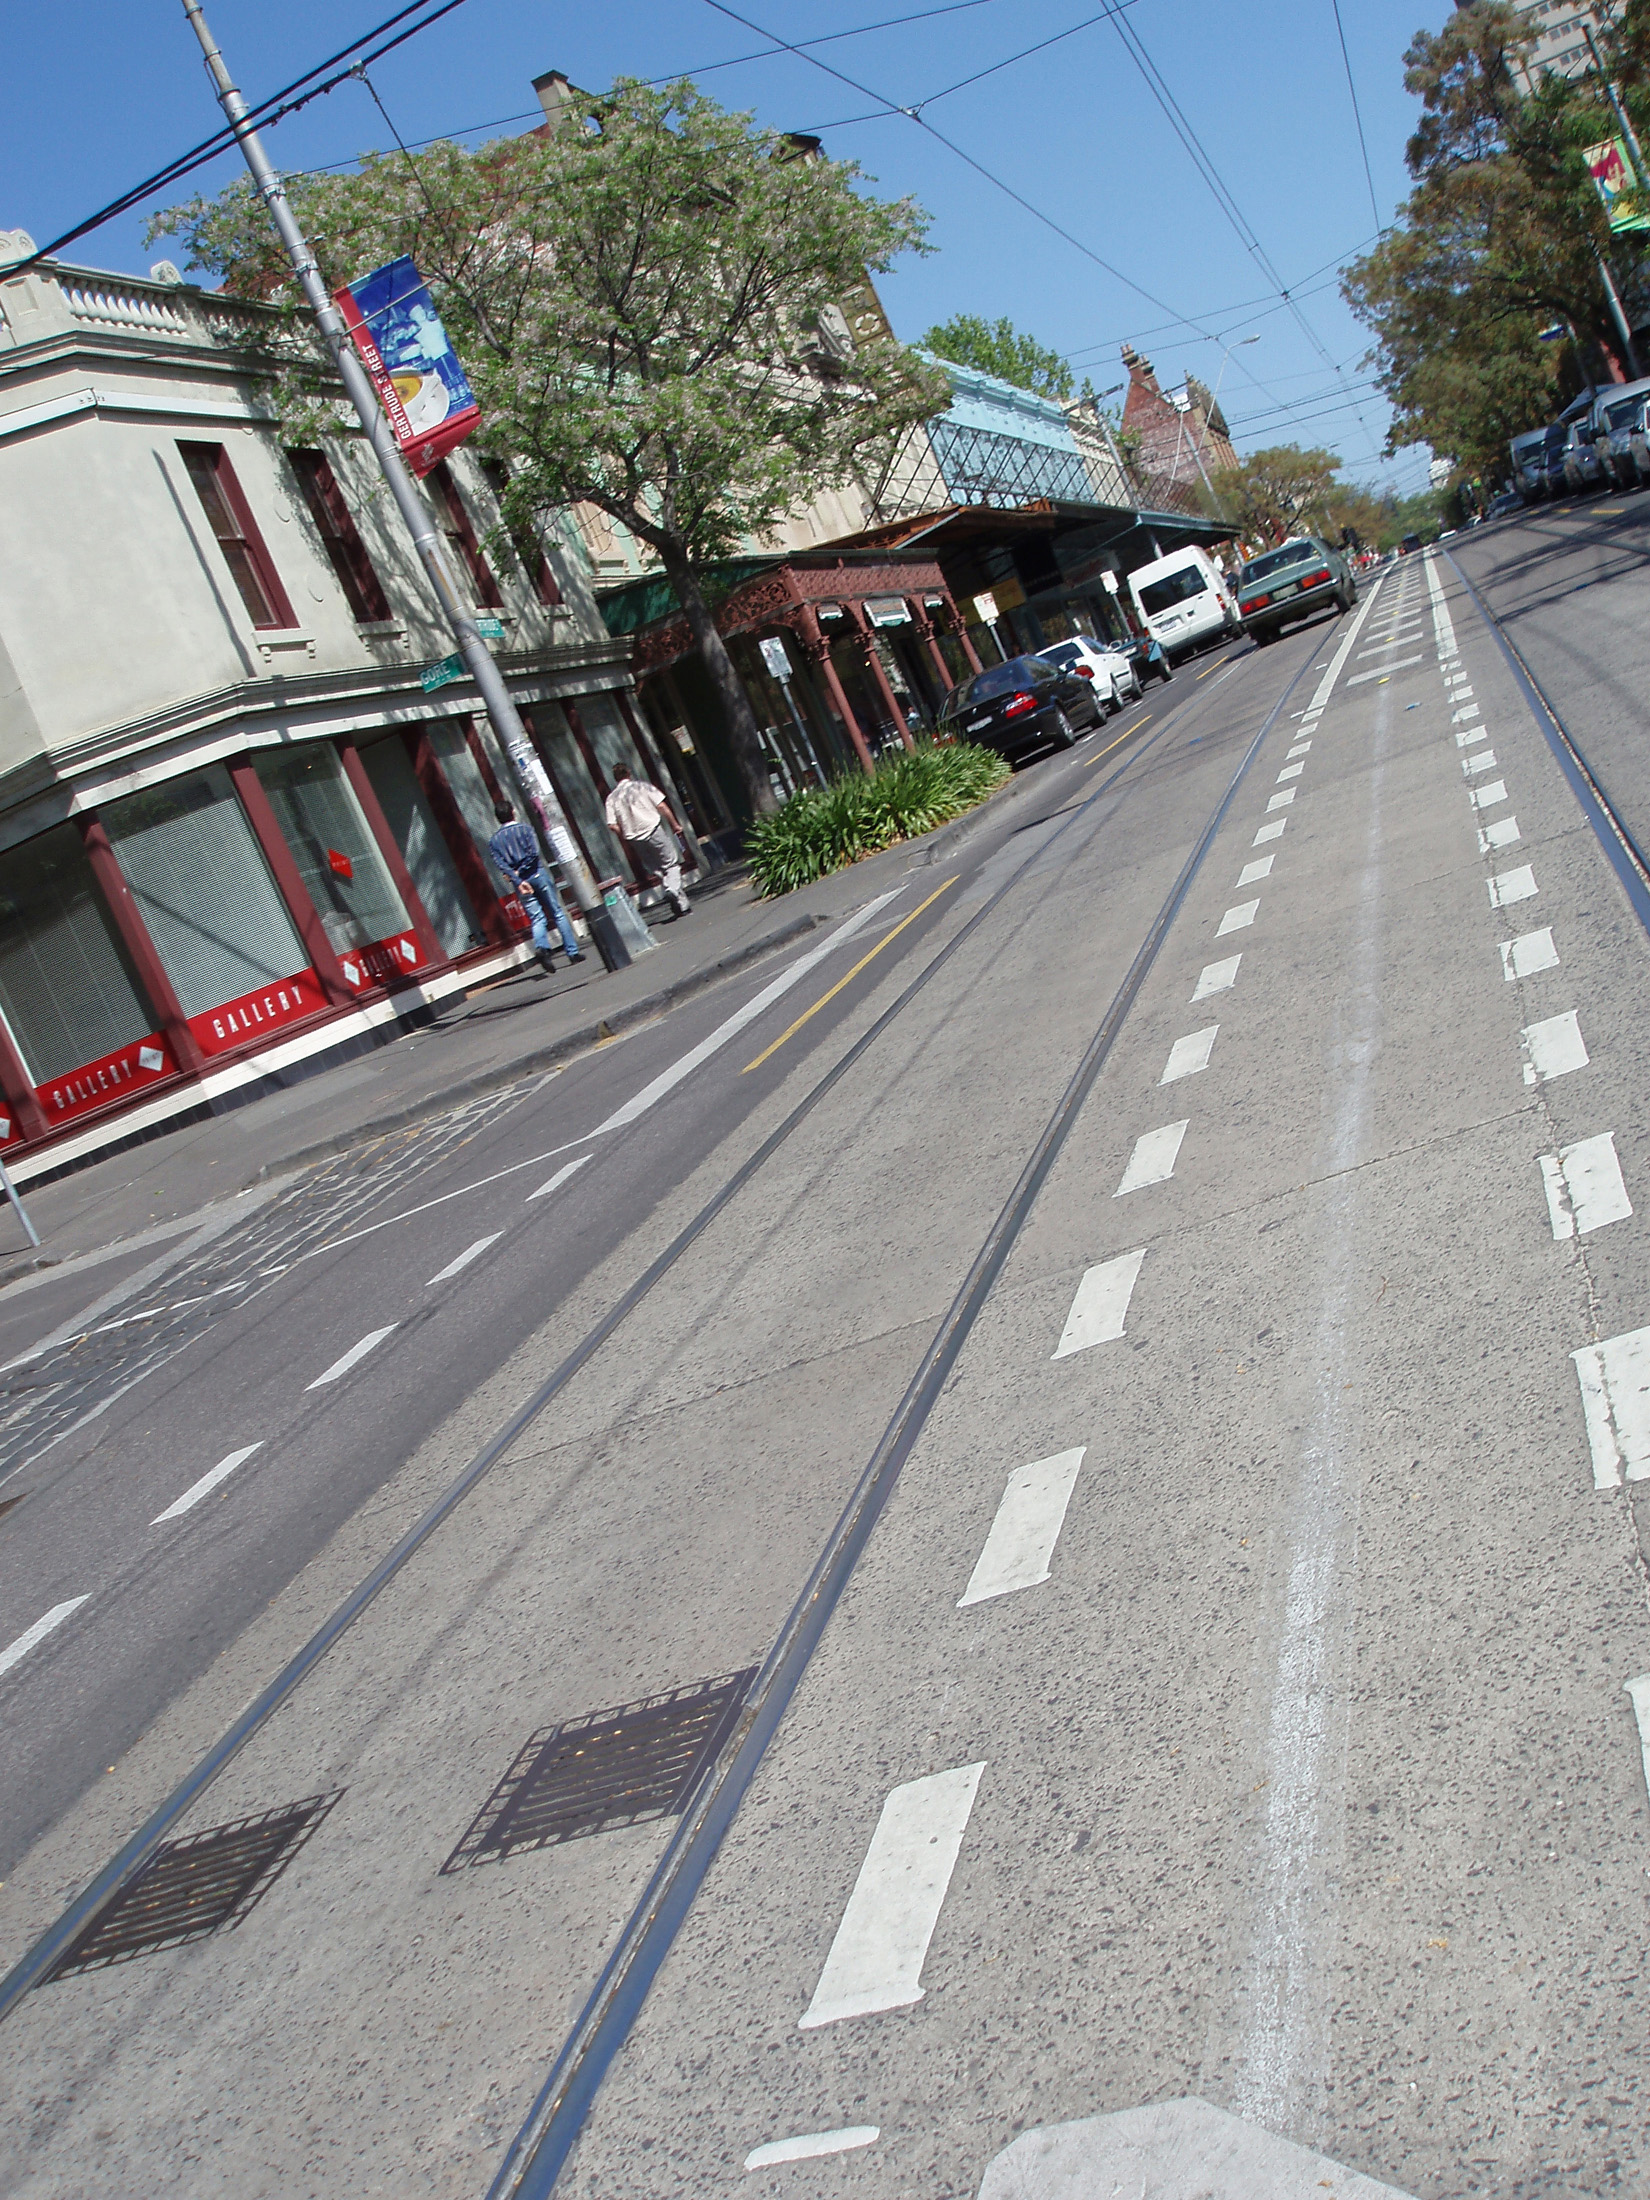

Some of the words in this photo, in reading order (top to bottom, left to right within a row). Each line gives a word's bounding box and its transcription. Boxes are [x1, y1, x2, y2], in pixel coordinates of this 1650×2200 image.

[362, 344, 389, 384] STREET
[382, 384, 412, 440] GERTRUDE
[420, 661, 451, 685] GORE
[212, 986, 303, 1039] GALLERY
[53, 1059, 132, 1109] GALLERY
